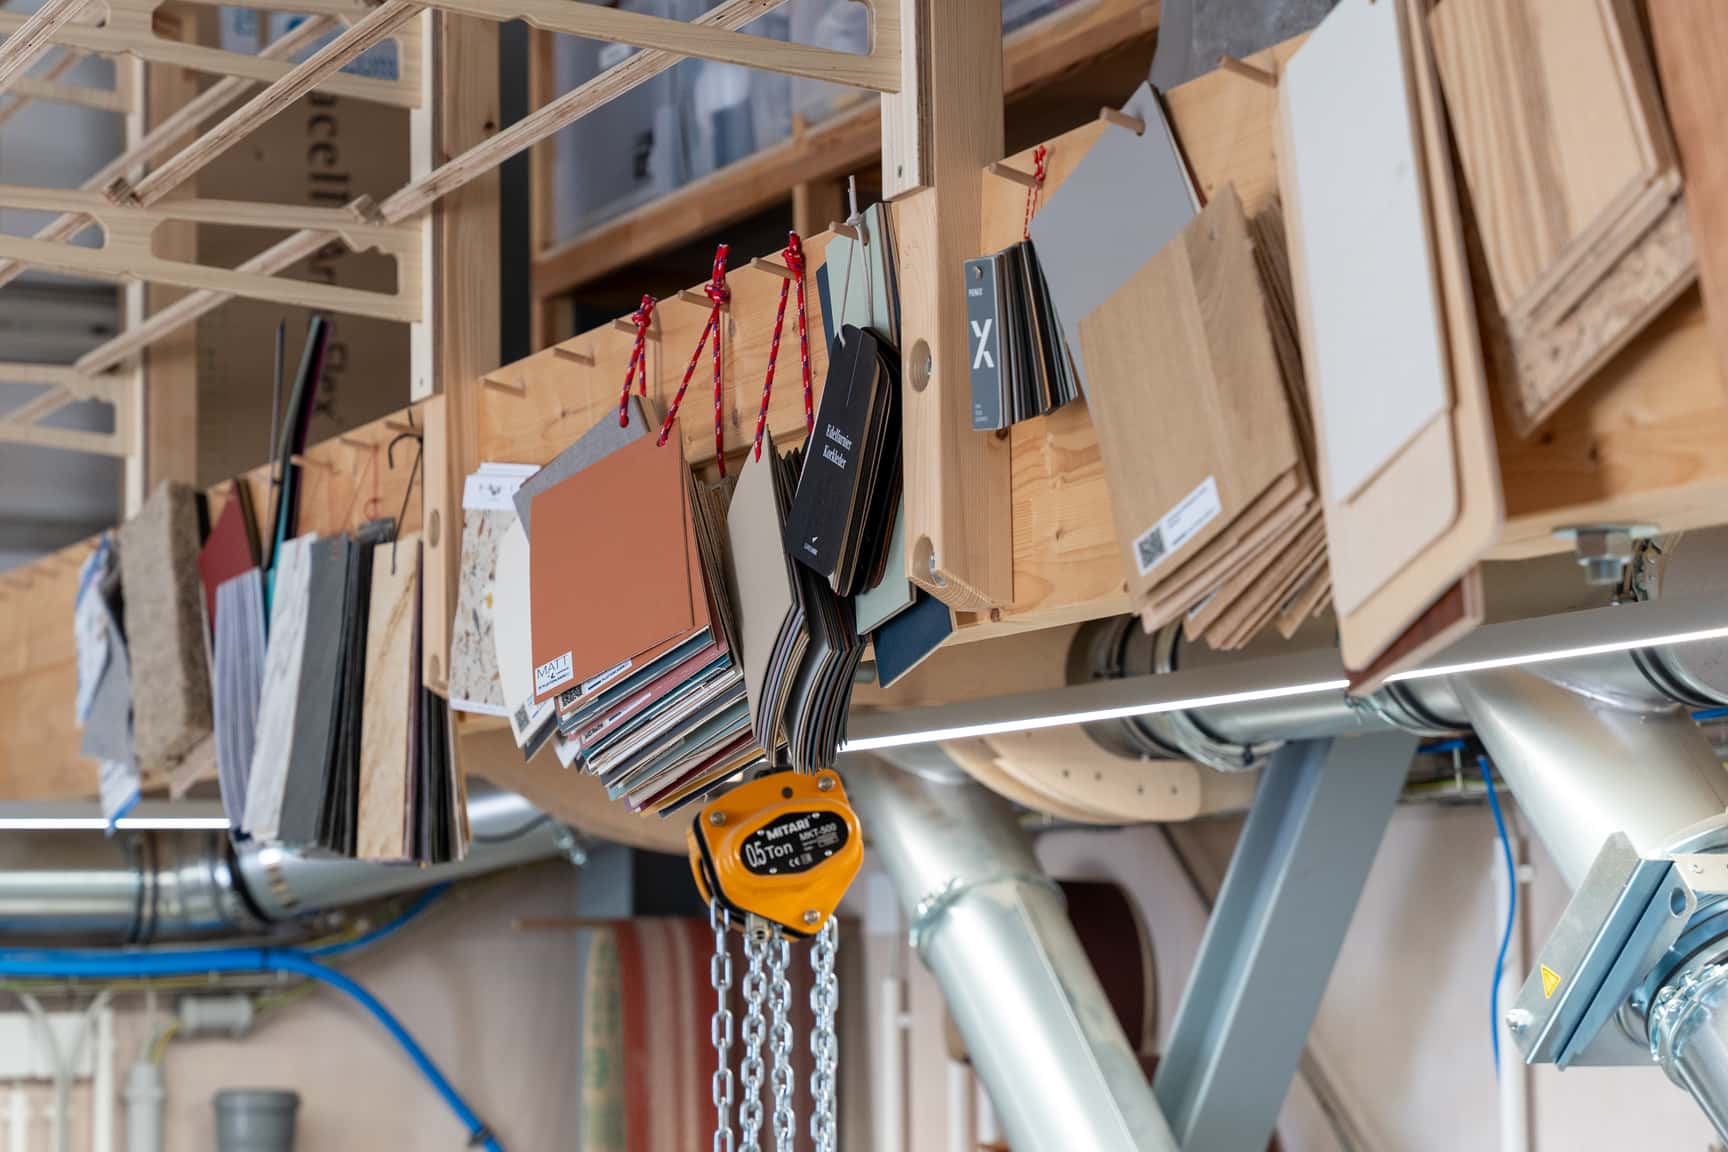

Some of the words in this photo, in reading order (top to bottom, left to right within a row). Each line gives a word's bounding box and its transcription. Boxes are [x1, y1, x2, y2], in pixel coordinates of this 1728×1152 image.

[537, 655, 569, 680] MATT
[766, 818, 810, 840] MITARI
[764, 843, 794, 860] Ton
